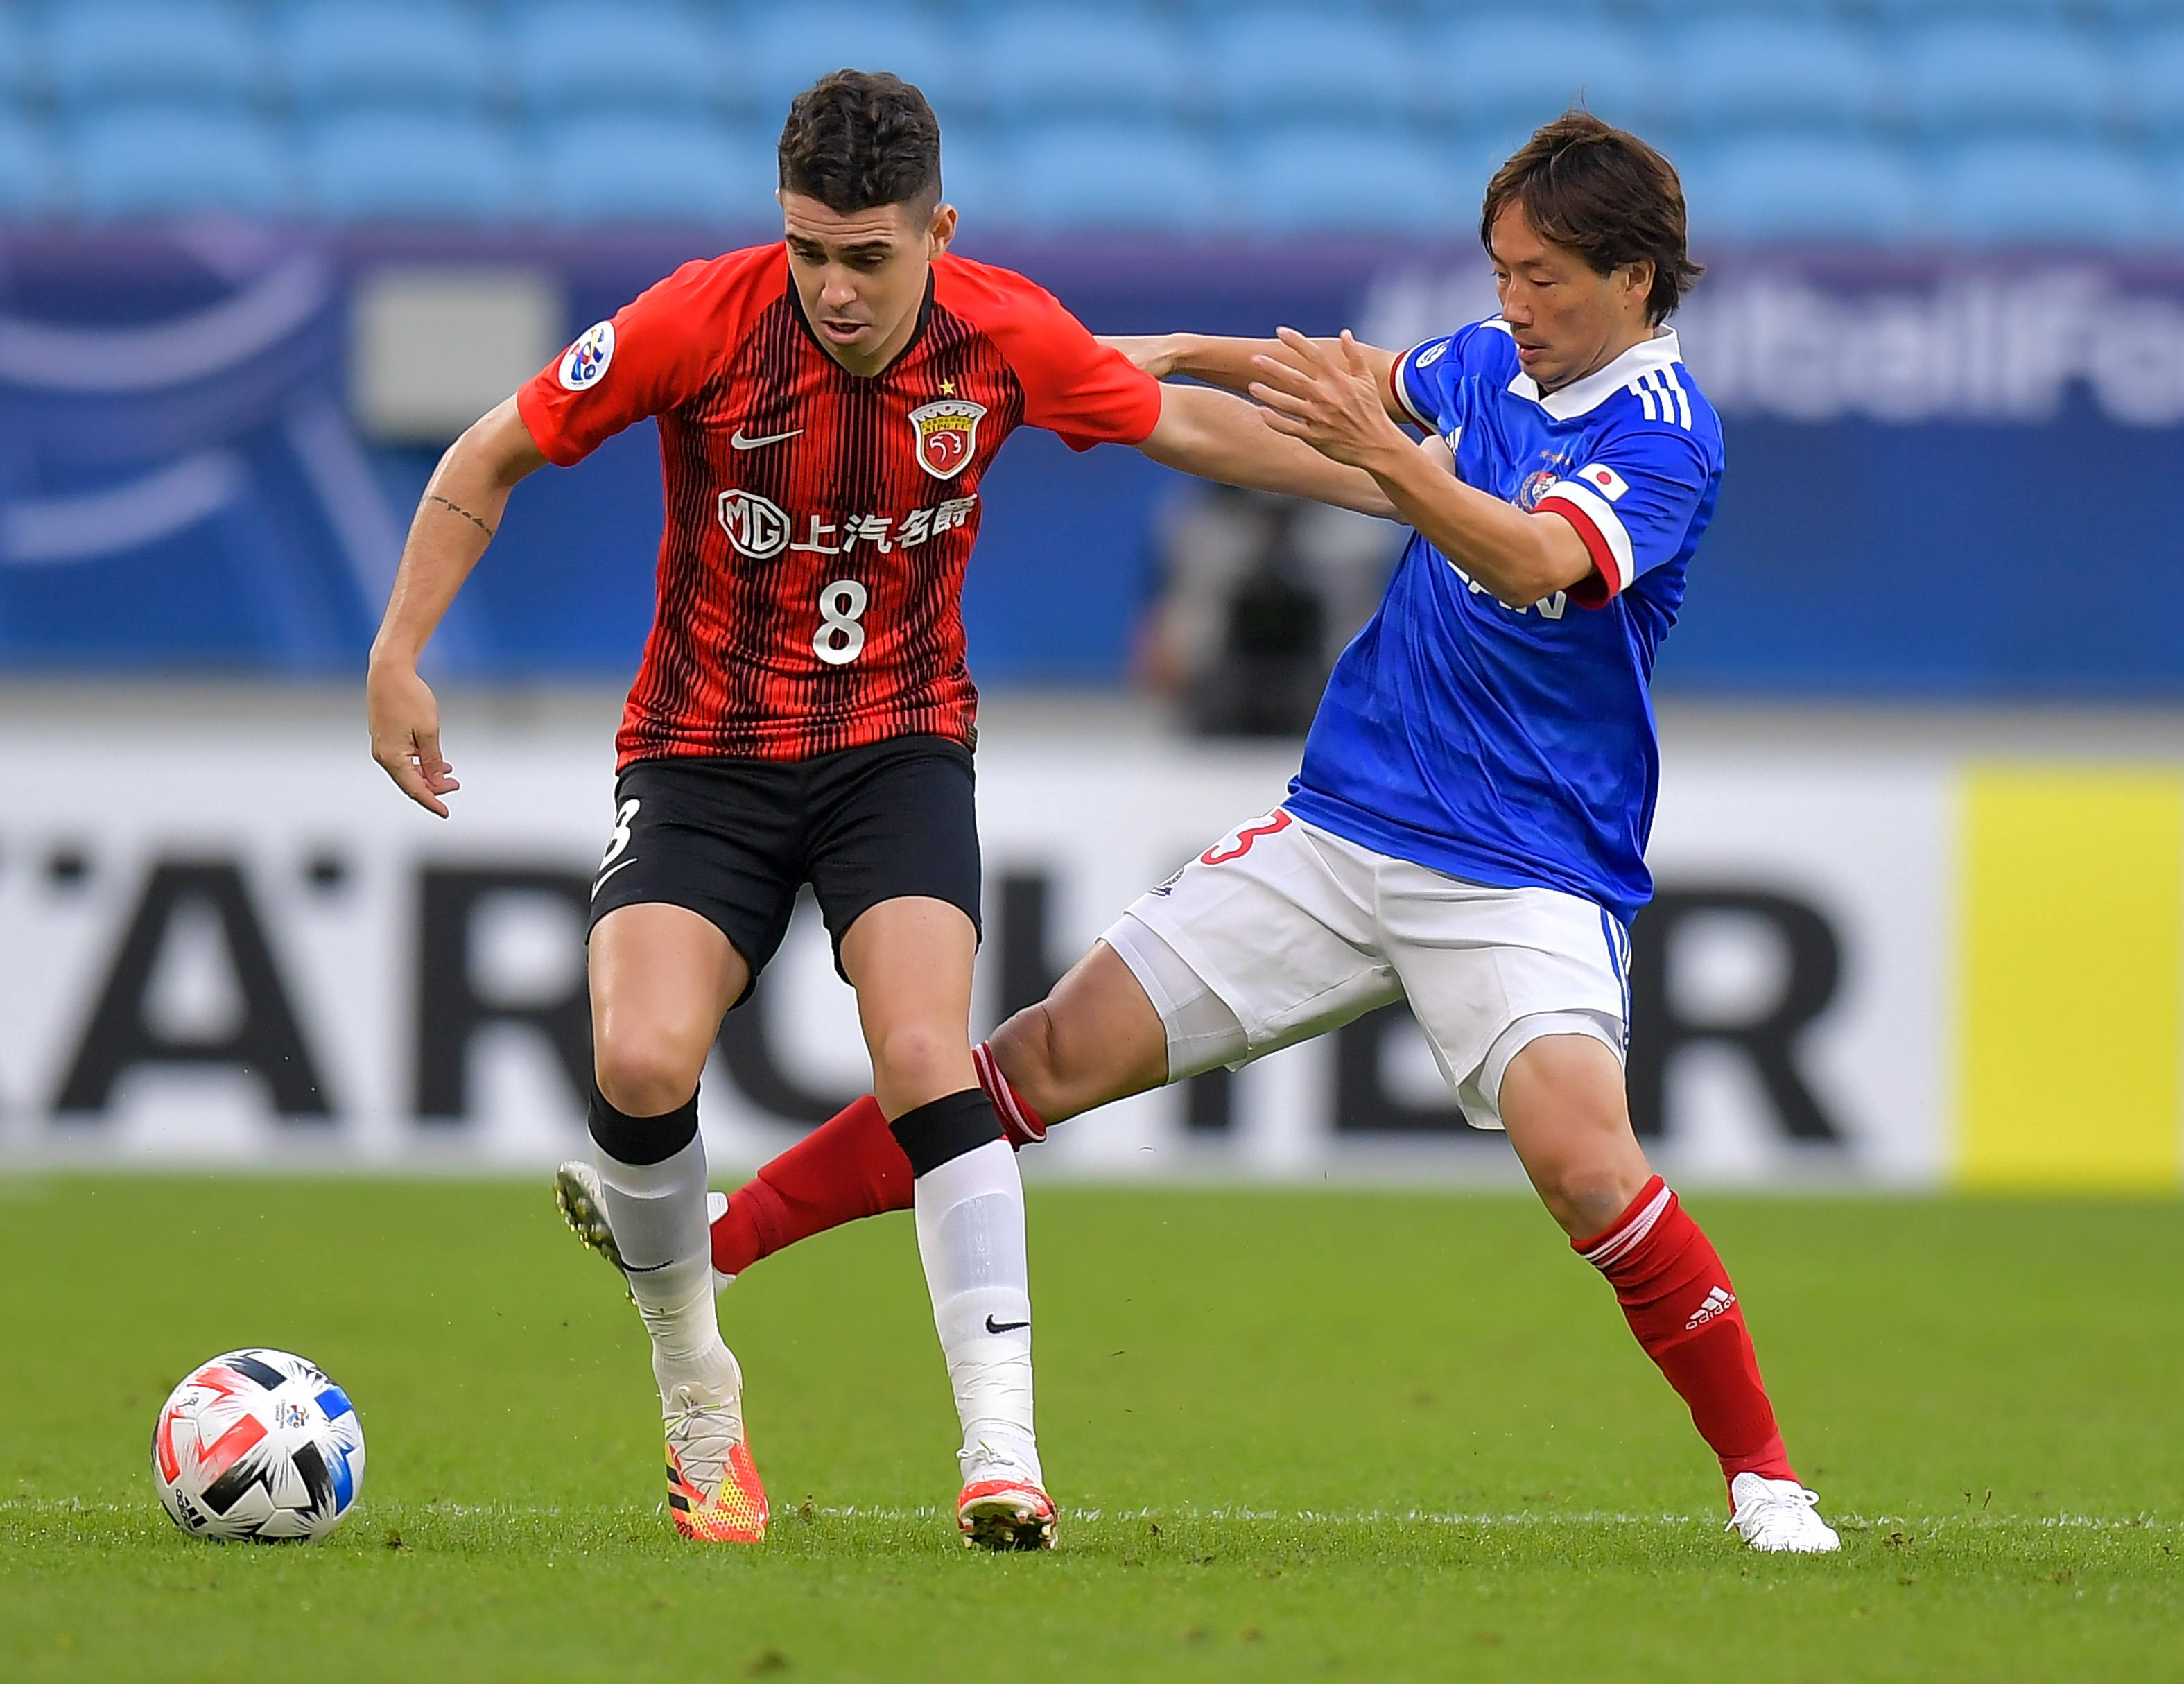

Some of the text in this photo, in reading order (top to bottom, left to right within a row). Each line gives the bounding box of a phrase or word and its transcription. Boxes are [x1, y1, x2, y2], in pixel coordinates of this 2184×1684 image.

[725, 496, 782, 553] MG
[790, 494, 978, 555] 上汽名爵
[812, 580, 867, 665] 8
[1200, 808, 1292, 865] 3
[1685, 1294, 1736, 1330] adidas
